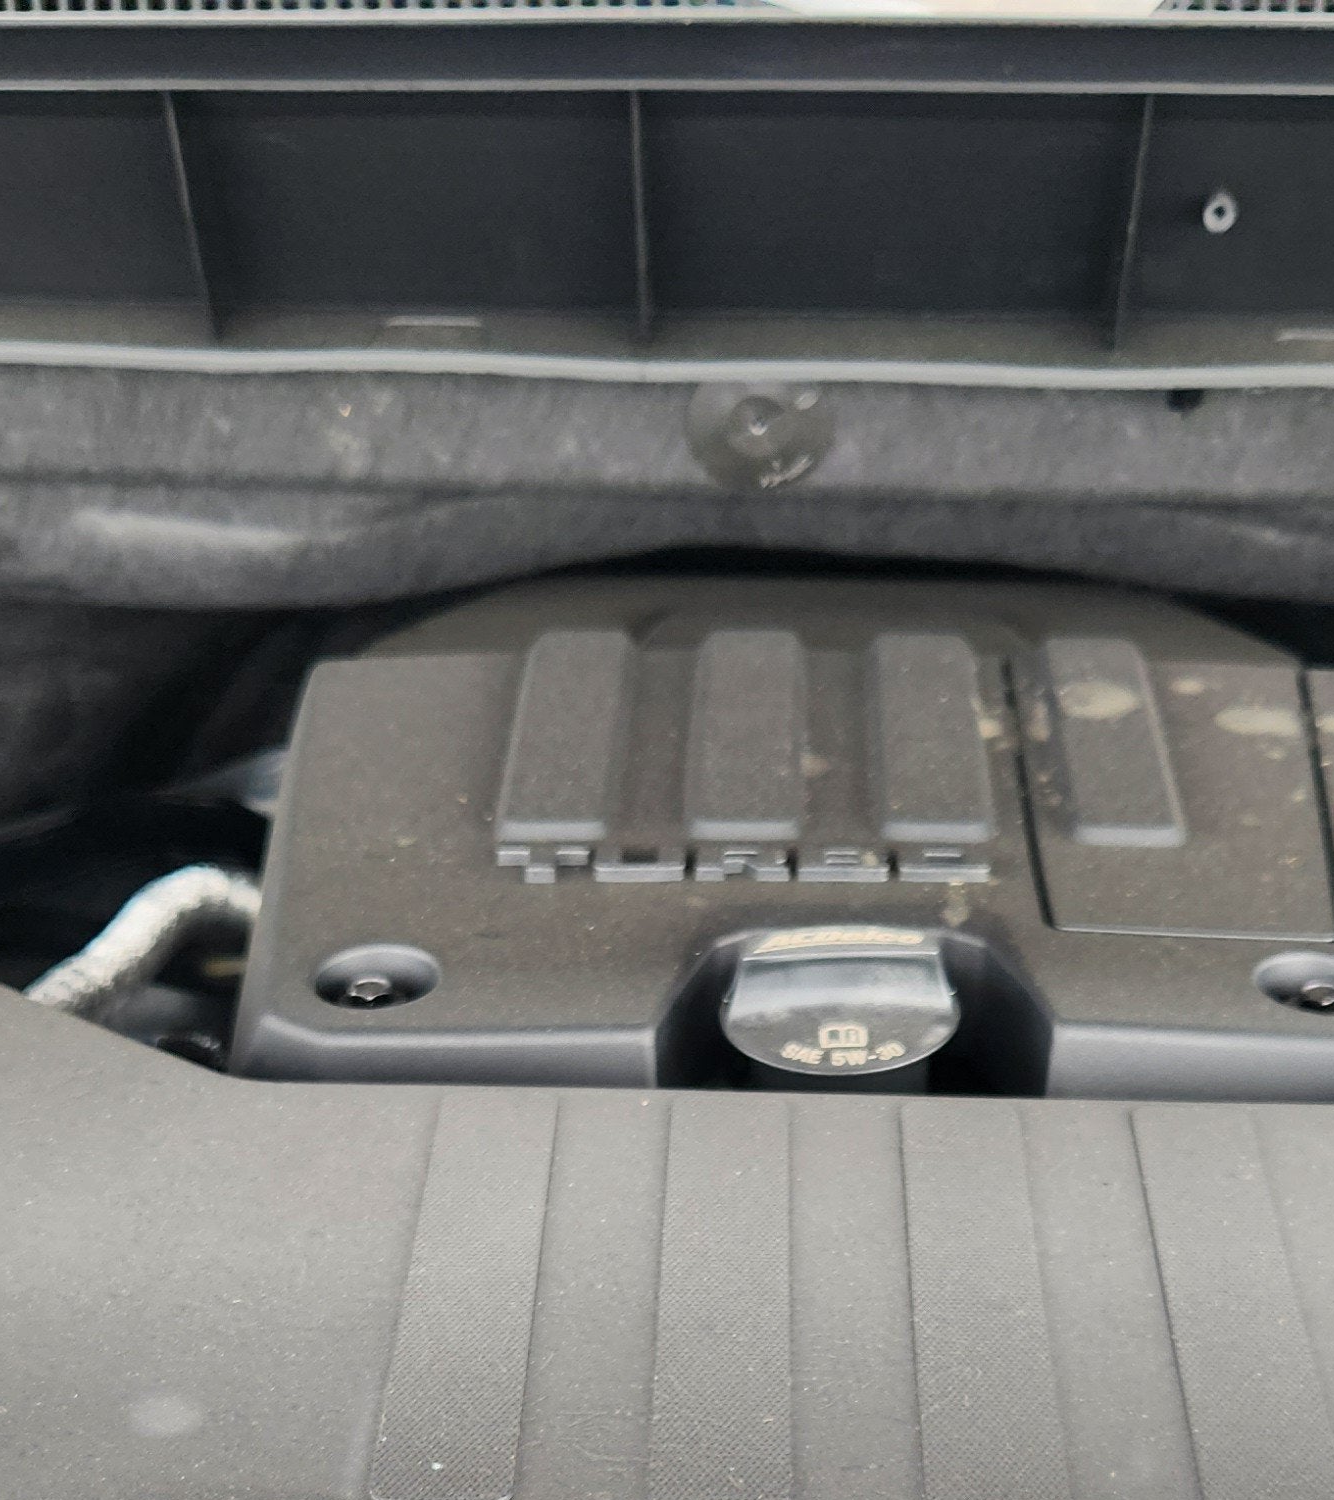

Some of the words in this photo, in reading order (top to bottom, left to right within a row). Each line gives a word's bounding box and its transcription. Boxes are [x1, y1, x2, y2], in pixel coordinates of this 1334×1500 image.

[497, 846, 991, 884] TURBO
[780, 1042, 825, 1064] SAE
[829, 1042, 905, 1066] 5W-30
